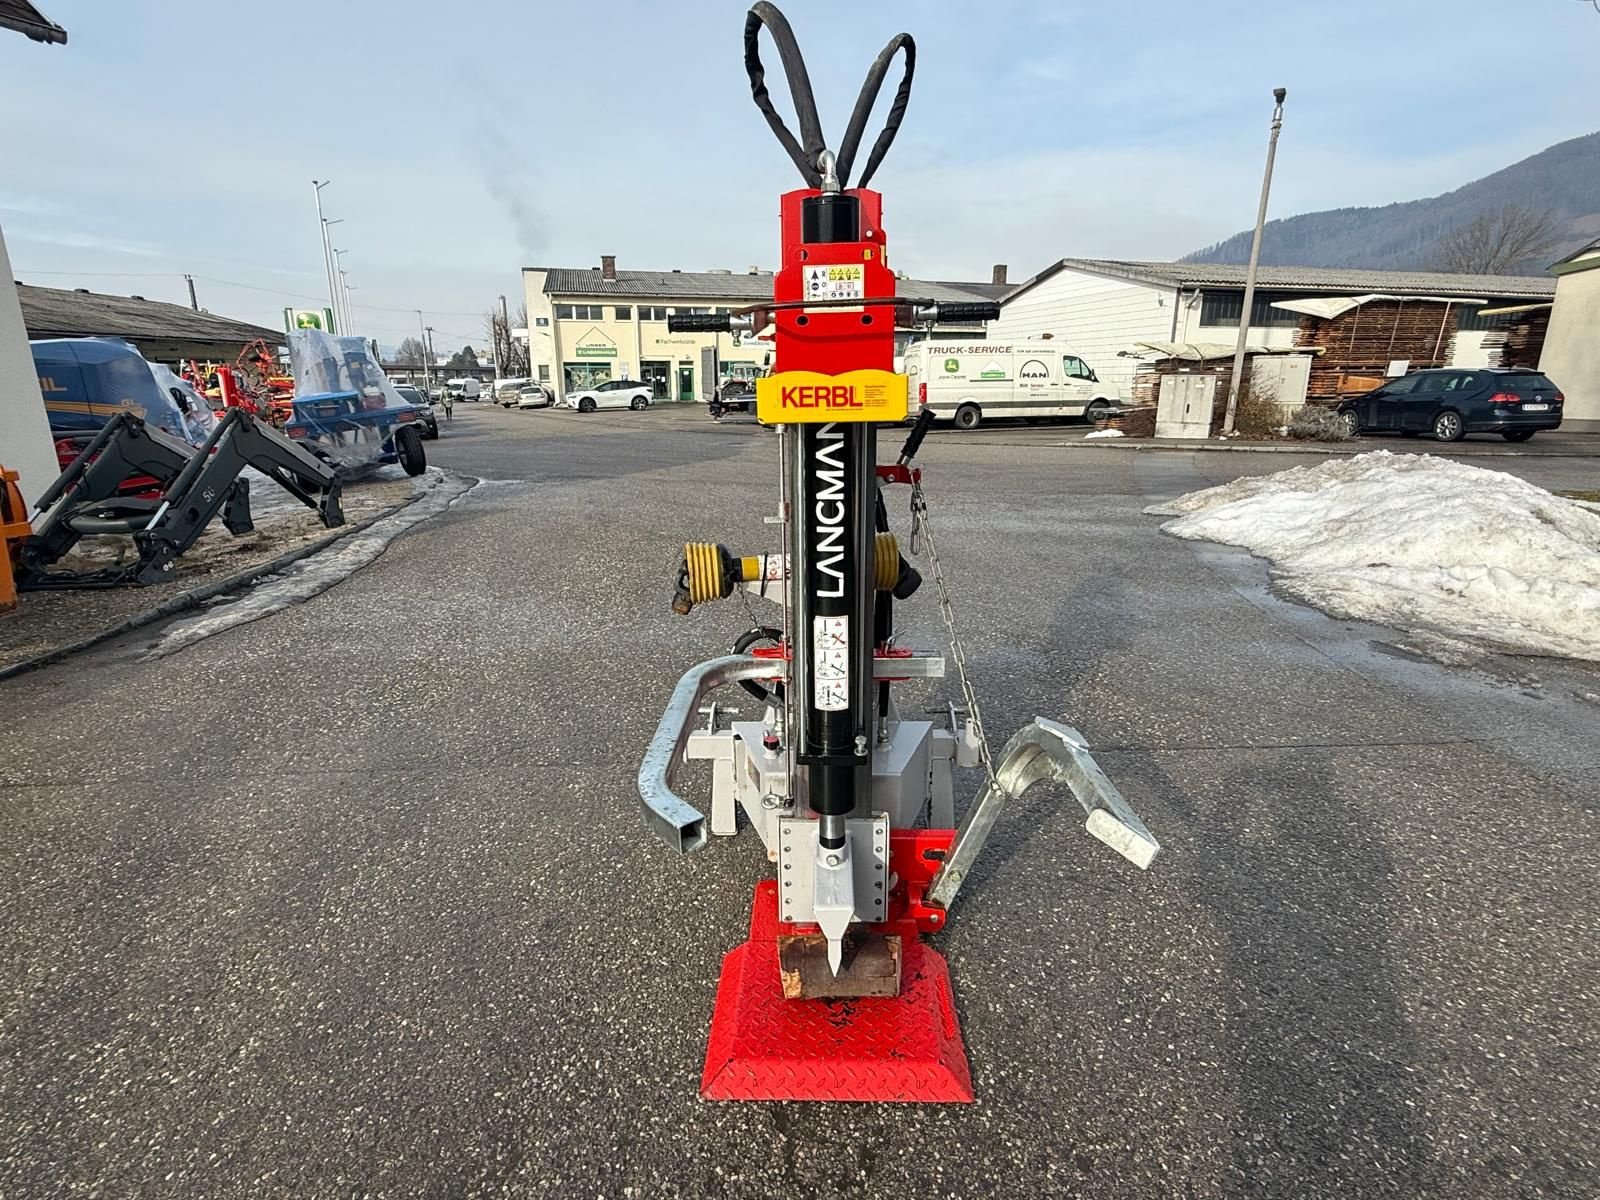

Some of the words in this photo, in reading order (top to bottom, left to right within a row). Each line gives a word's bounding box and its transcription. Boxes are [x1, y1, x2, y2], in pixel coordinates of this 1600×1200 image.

[927, 346, 1013, 354] TRUCK-SERVICE
[781, 385, 864, 408] KERBL
[815, 422, 845, 598] LANCMAN
